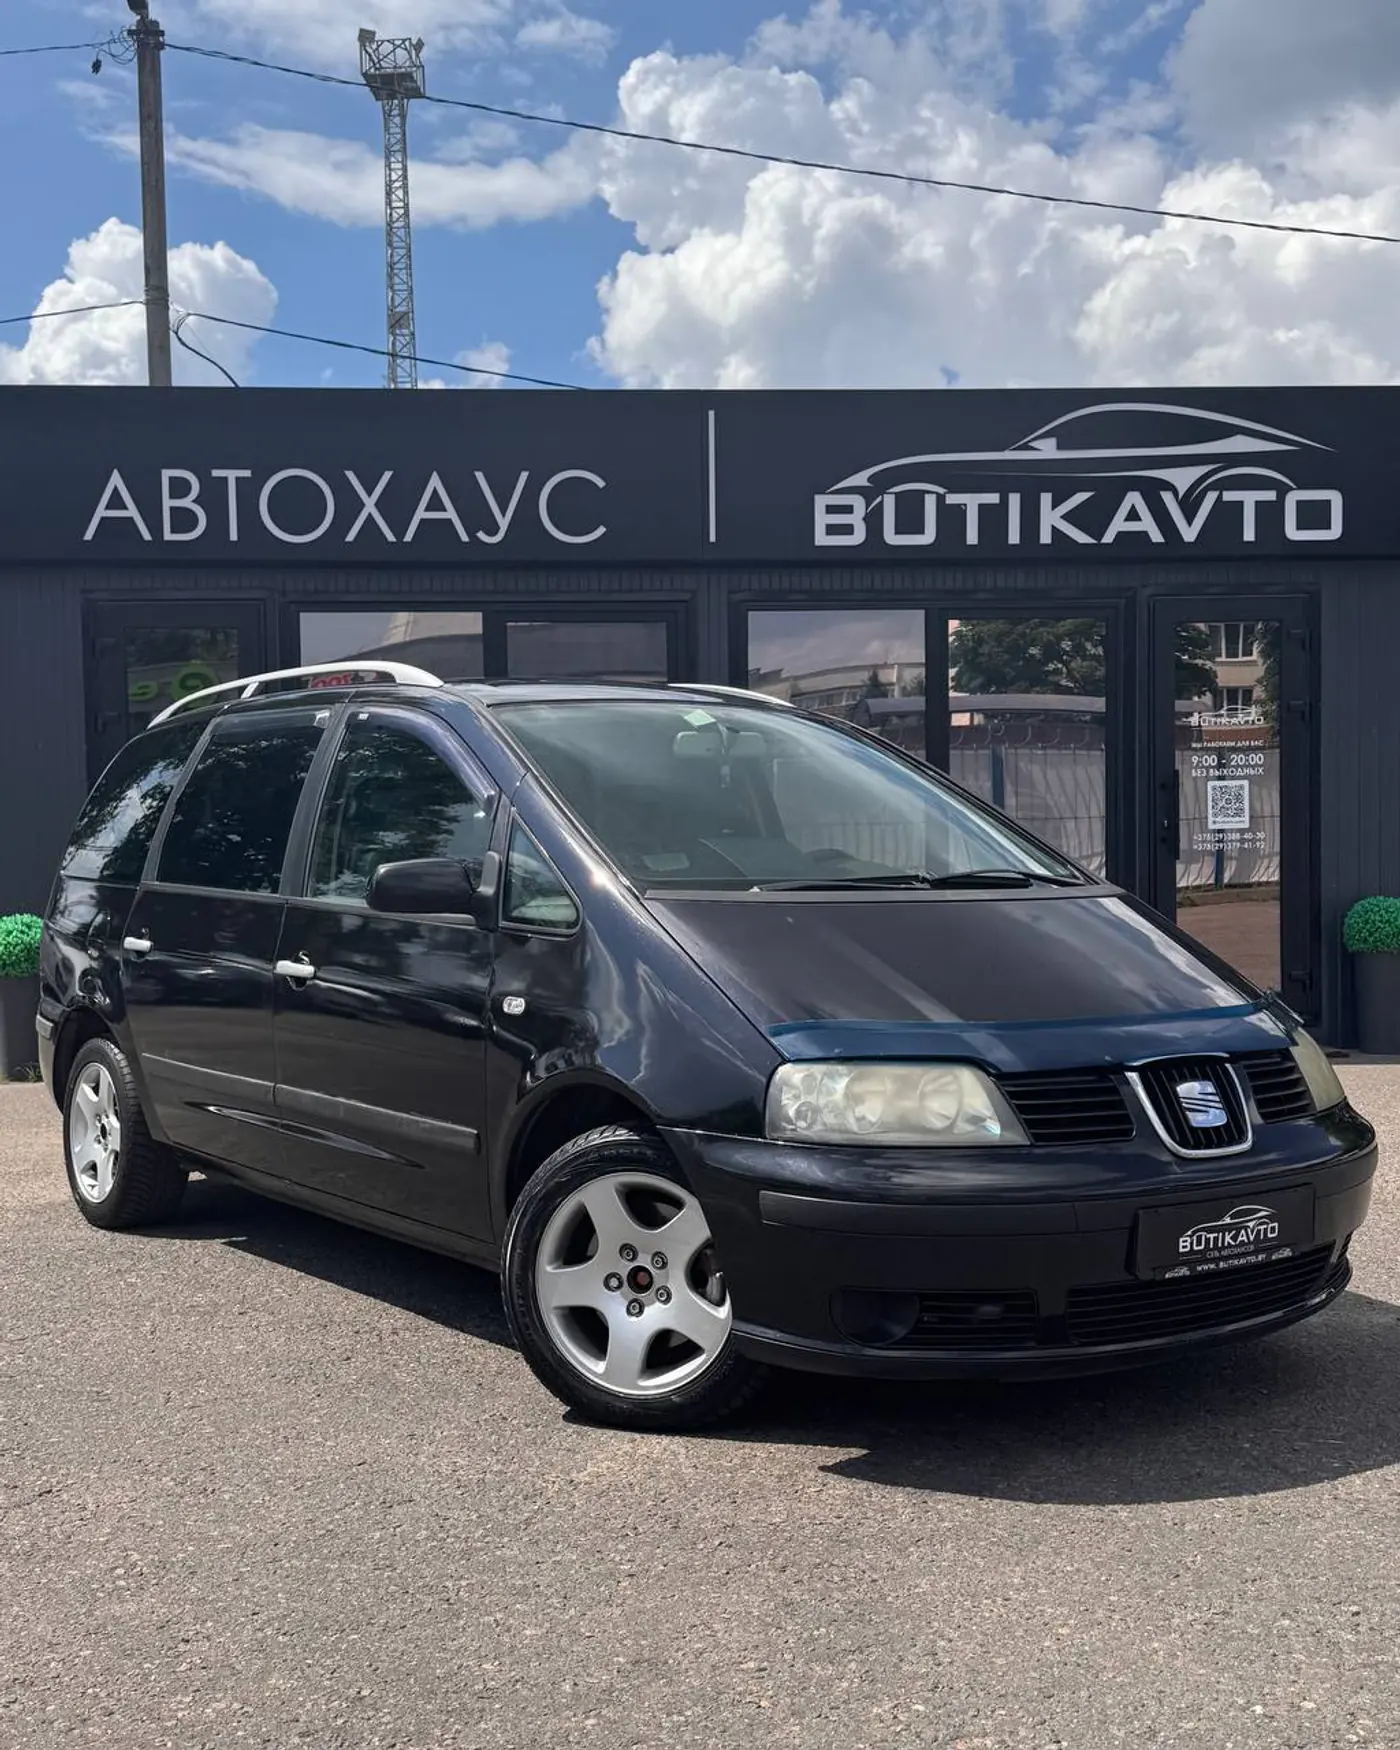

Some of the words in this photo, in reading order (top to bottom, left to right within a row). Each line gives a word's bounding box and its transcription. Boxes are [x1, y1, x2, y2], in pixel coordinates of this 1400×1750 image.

[83, 468, 607, 544] АВТОХАУС
[814, 489, 1343, 547] BUTIKAVTO
[1191, 755, 1218, 767] 9:00
[1230, 754, 1265, 766] 20:00
[1191, 768, 1207, 777] БЕЗ
[1209, 767, 1265, 777] ВЫХОДНЫХ
[1179, 1222, 1279, 1253] BUTIKAVTO
